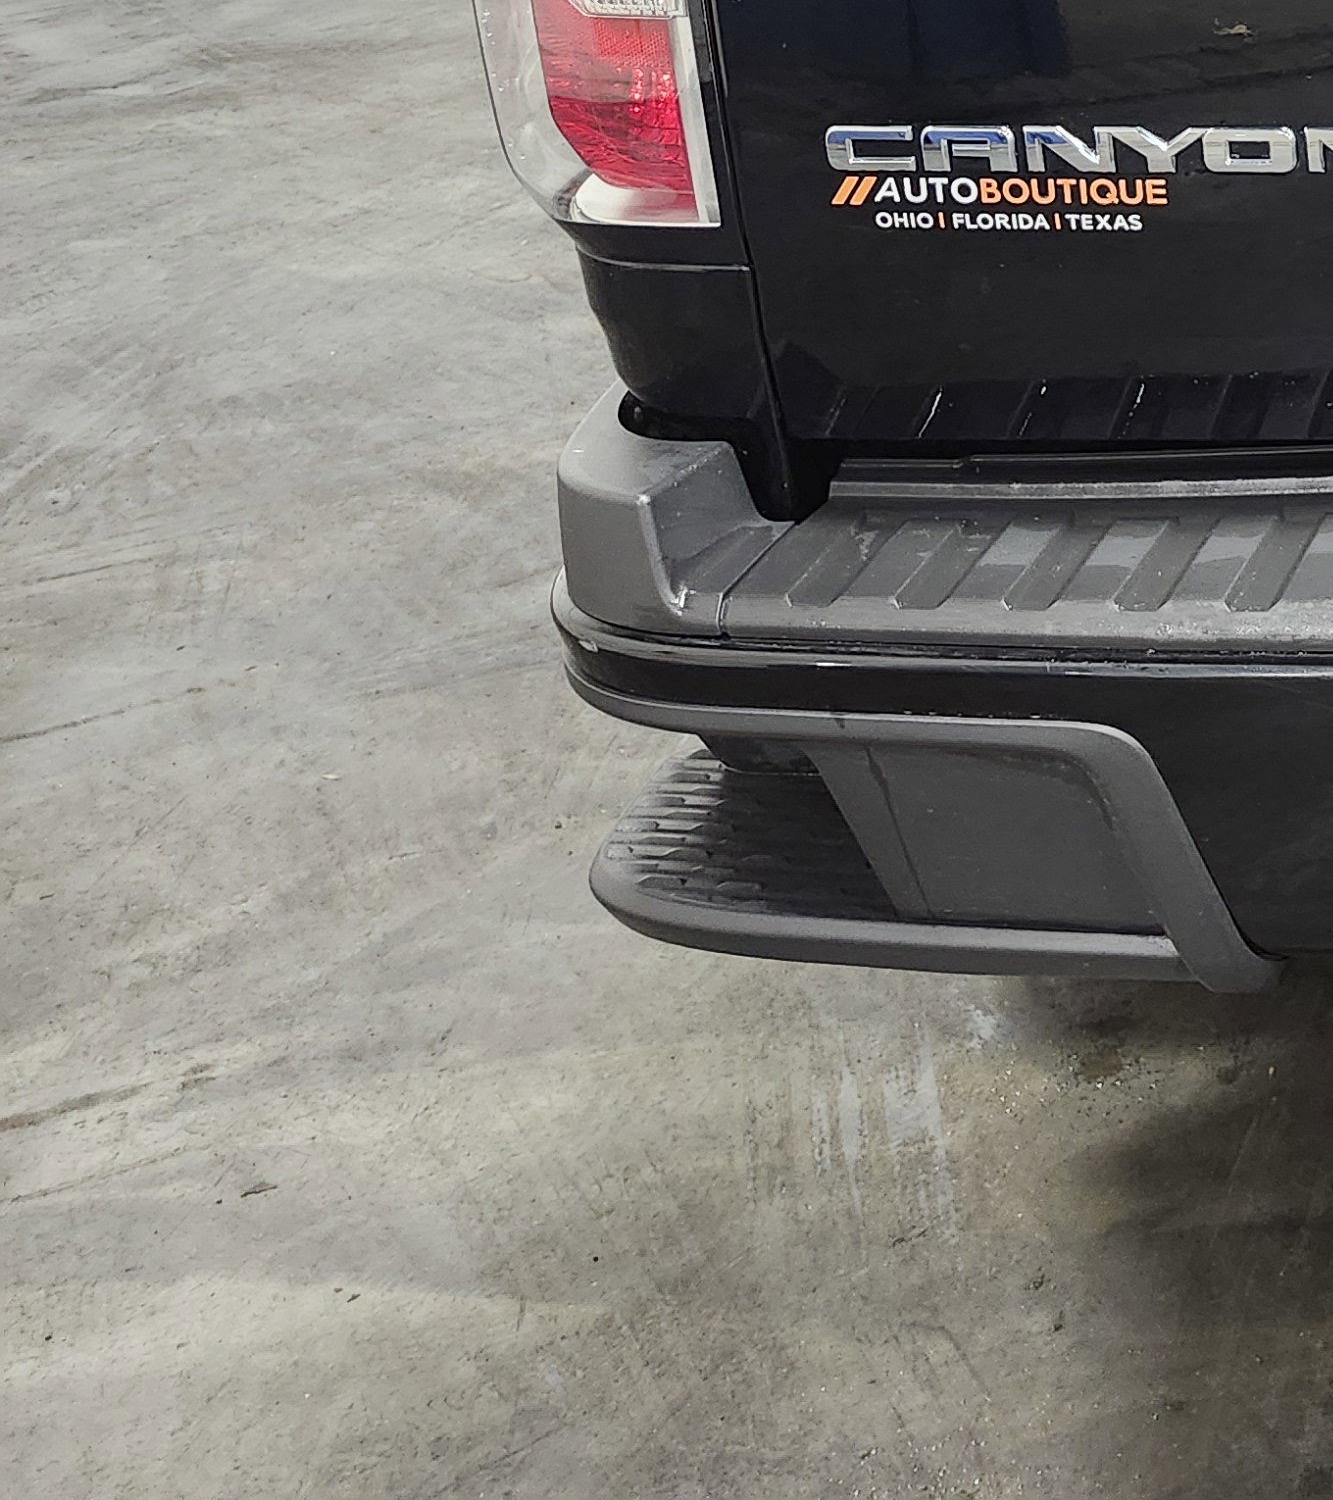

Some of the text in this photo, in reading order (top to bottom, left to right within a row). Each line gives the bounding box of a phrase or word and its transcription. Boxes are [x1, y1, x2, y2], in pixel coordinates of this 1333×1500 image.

[873, 176, 1169, 206] AUTOBOUTIQUE
[875, 211, 1143, 231] OHIO FLORIDA TEXAS
